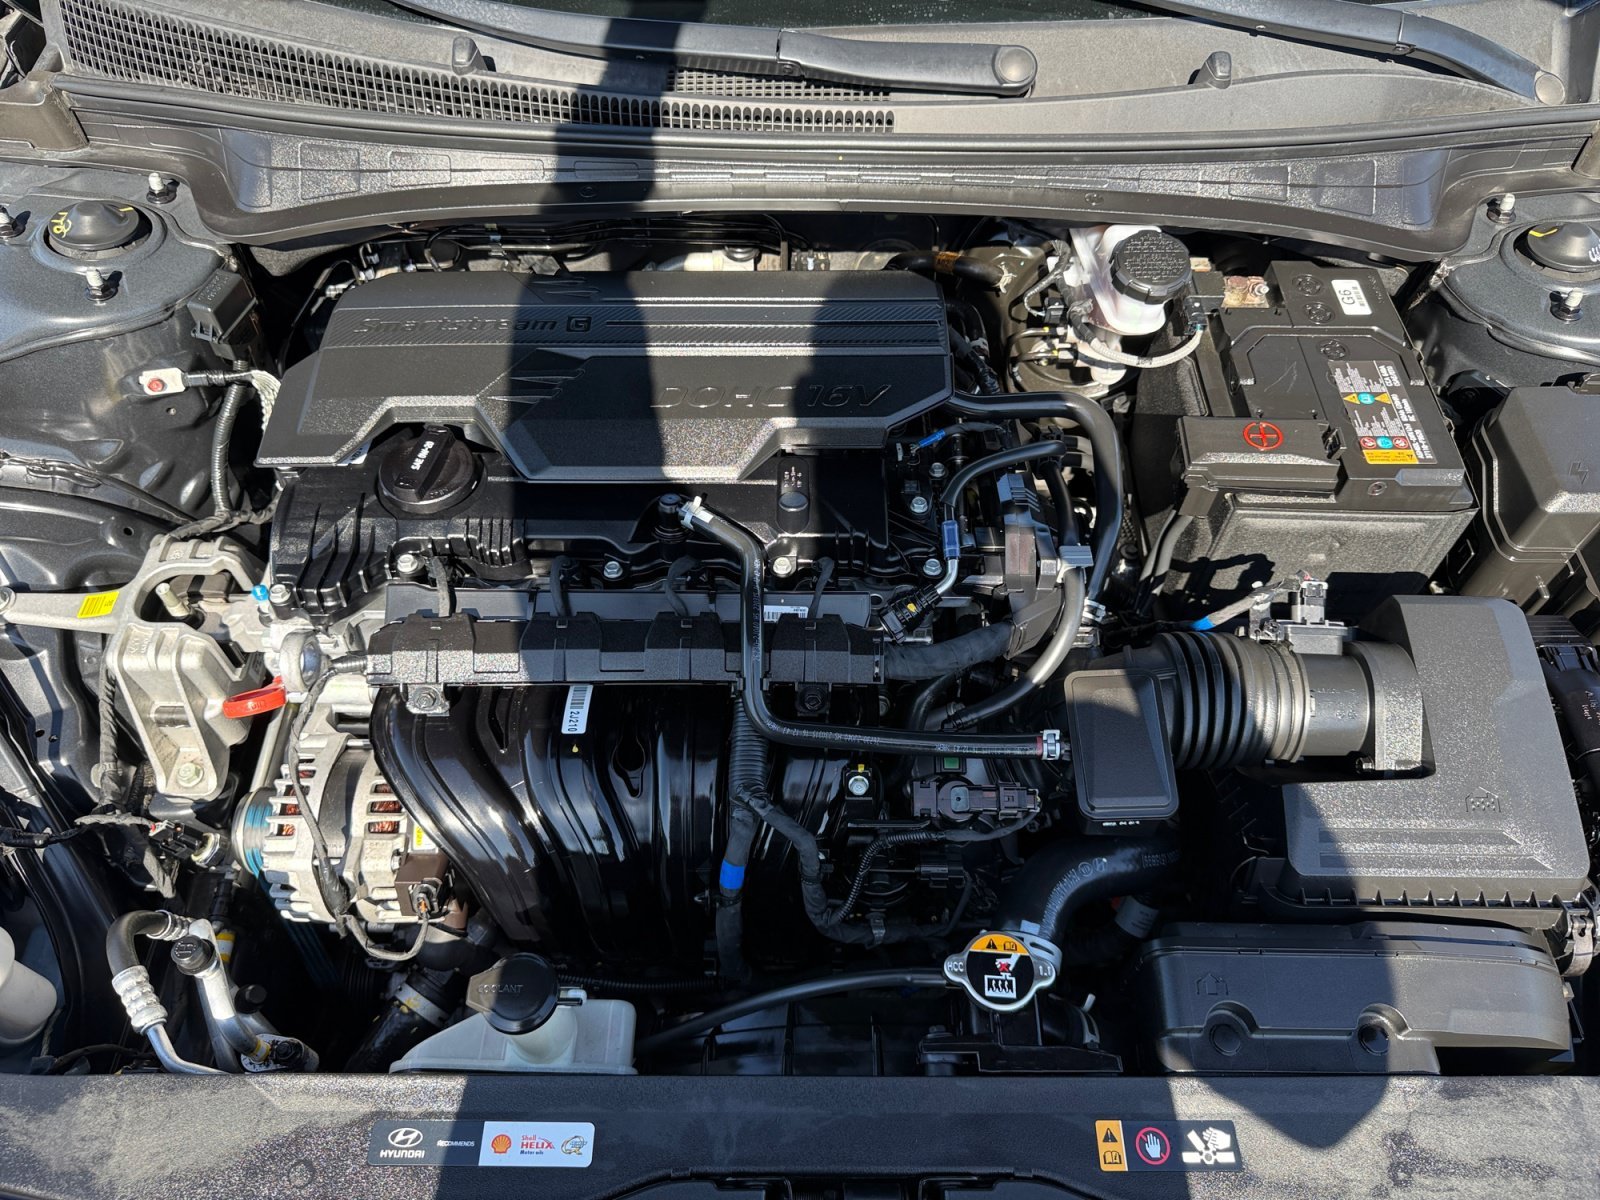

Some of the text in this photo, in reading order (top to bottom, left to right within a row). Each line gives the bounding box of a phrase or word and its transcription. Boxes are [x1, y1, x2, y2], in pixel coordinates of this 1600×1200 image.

[1338, 289, 1355, 305] G6
[353, 317, 557, 333] Smartstream
[650, 384, 892, 408] DOHC 16V
[410, 456, 422, 471] SAE
[567, 710, 580, 732] 2J210
[947, 961, 1052, 977] HCC 1.1
[478, 984, 524, 994] COOLANT
[436, 1139, 475, 1147] RECOMMENDS
[520, 1141, 554, 1149] HELIX
[379, 1149, 425, 1159] HYUNDAI
